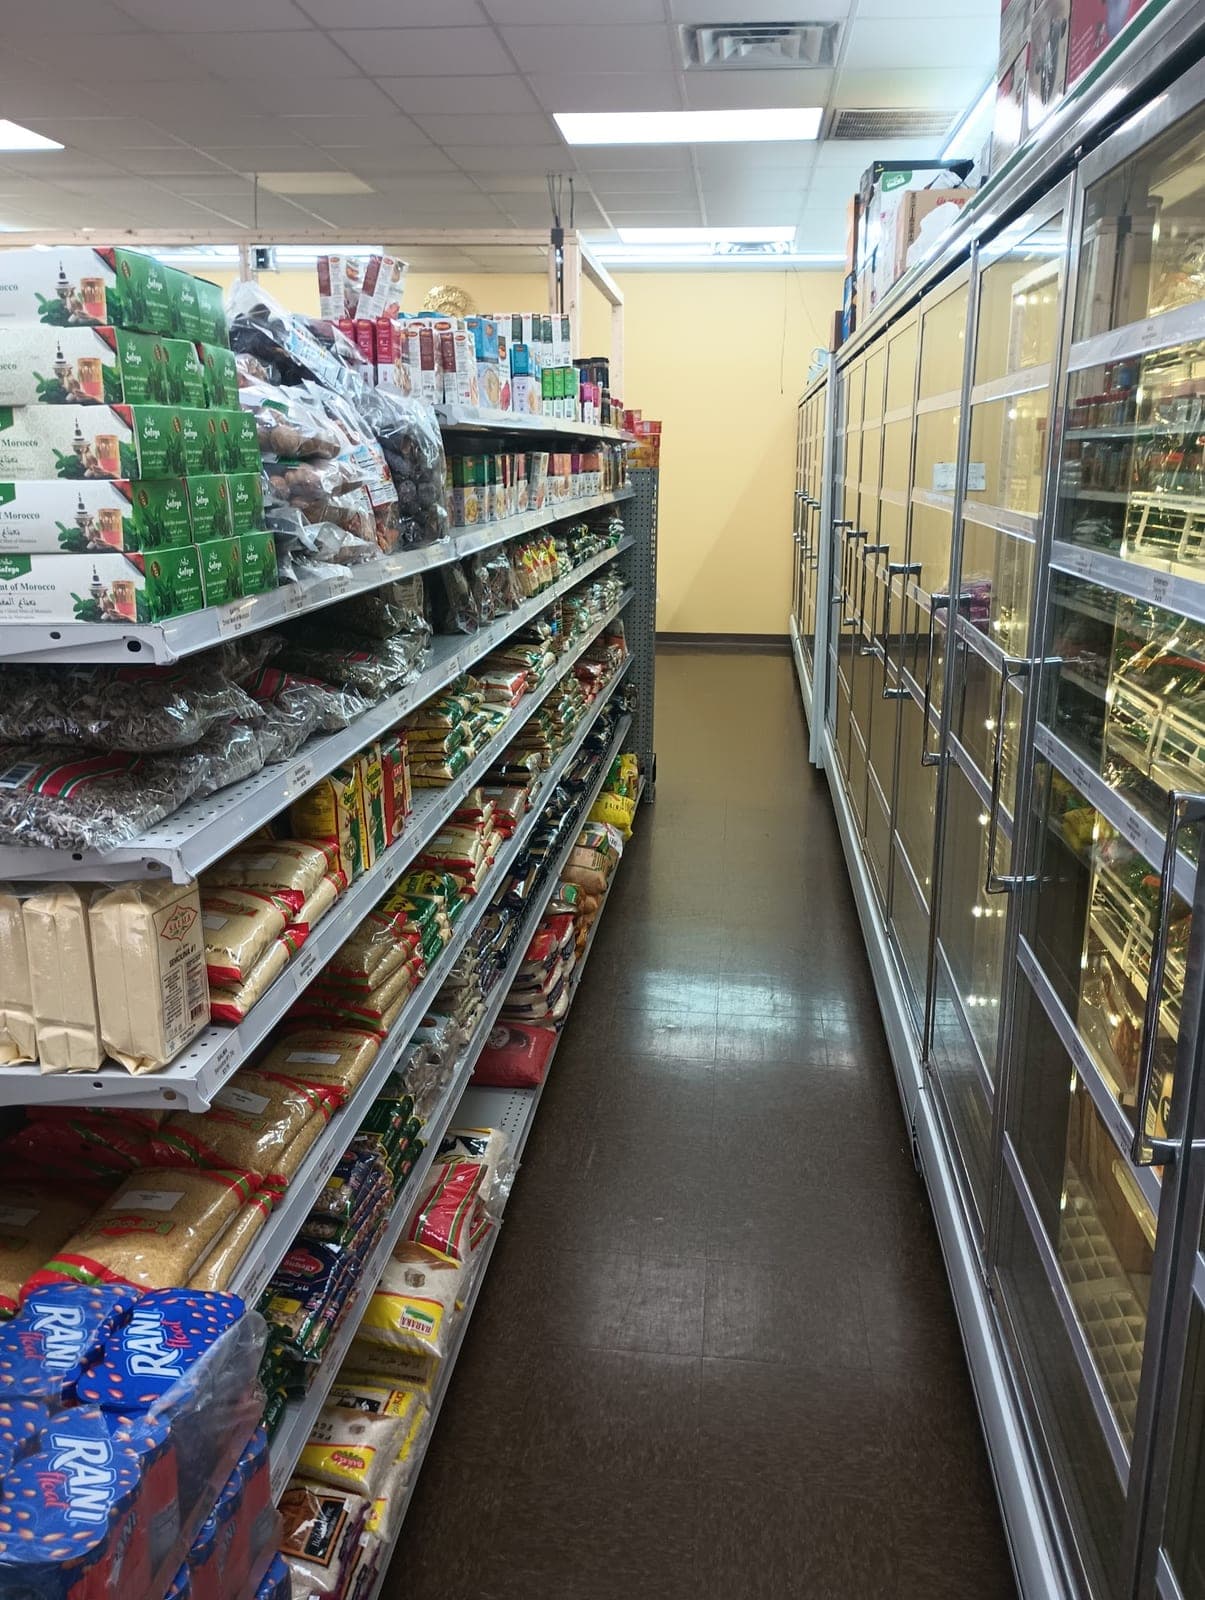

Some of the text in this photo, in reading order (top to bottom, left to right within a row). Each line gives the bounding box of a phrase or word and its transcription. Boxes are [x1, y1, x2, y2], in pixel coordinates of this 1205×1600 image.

[2, 439, 38, 448] Morocco
[4, 511, 40, 520] Morocco
[10, 582, 18, 591] of
[20, 582, 56, 591] Morocco
[31, 1303, 86, 1369] RANI
[125, 1311, 183, 1377] RANI
[51, 1435, 114, 1522] RANI
